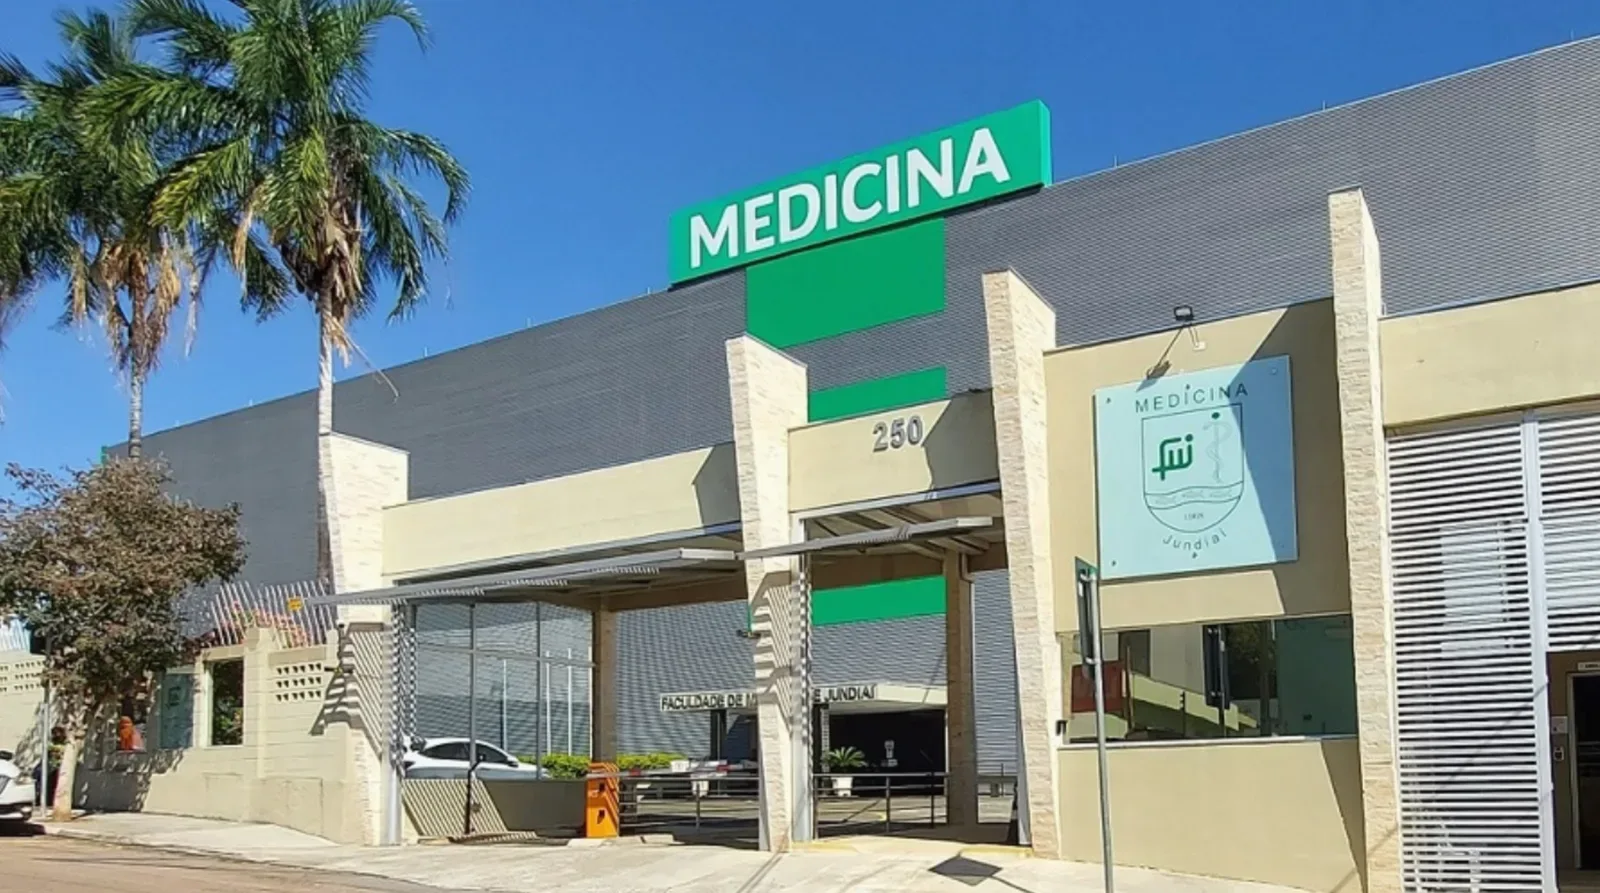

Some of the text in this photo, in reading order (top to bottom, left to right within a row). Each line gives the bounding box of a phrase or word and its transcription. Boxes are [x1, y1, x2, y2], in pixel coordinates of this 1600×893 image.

[690, 127, 1010, 269] MEDICINA
[872, 415, 923, 452] 250
[661, 693, 725, 711] FACULDADE
[727, 693, 744, 707] DE
